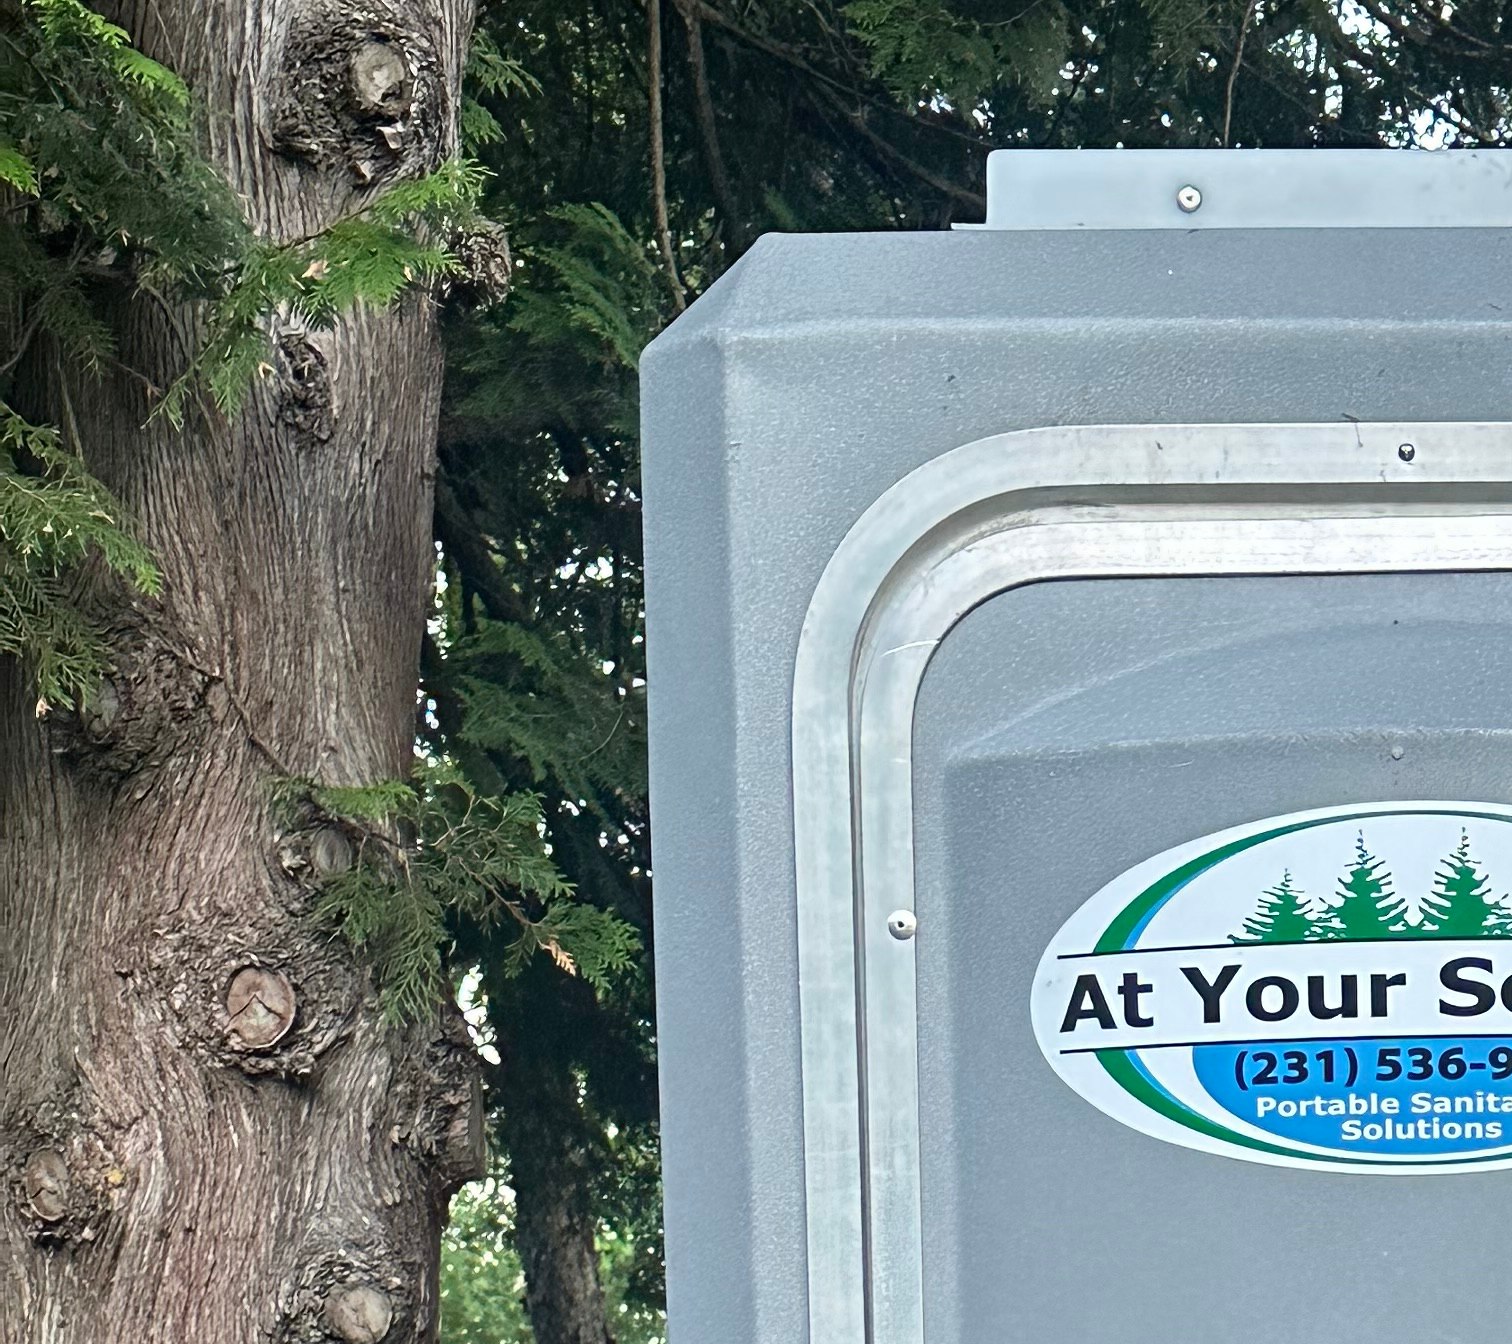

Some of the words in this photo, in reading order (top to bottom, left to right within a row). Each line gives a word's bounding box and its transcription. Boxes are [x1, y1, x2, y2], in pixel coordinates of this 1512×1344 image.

[1059, 971, 1155, 1033] At
[1179, 964, 1405, 1024] Your
[1234, 1047, 1359, 1091] (231)
[1256, 1091, 1399, 1119] Portable
[1340, 1115, 1503, 1142] Solutions
